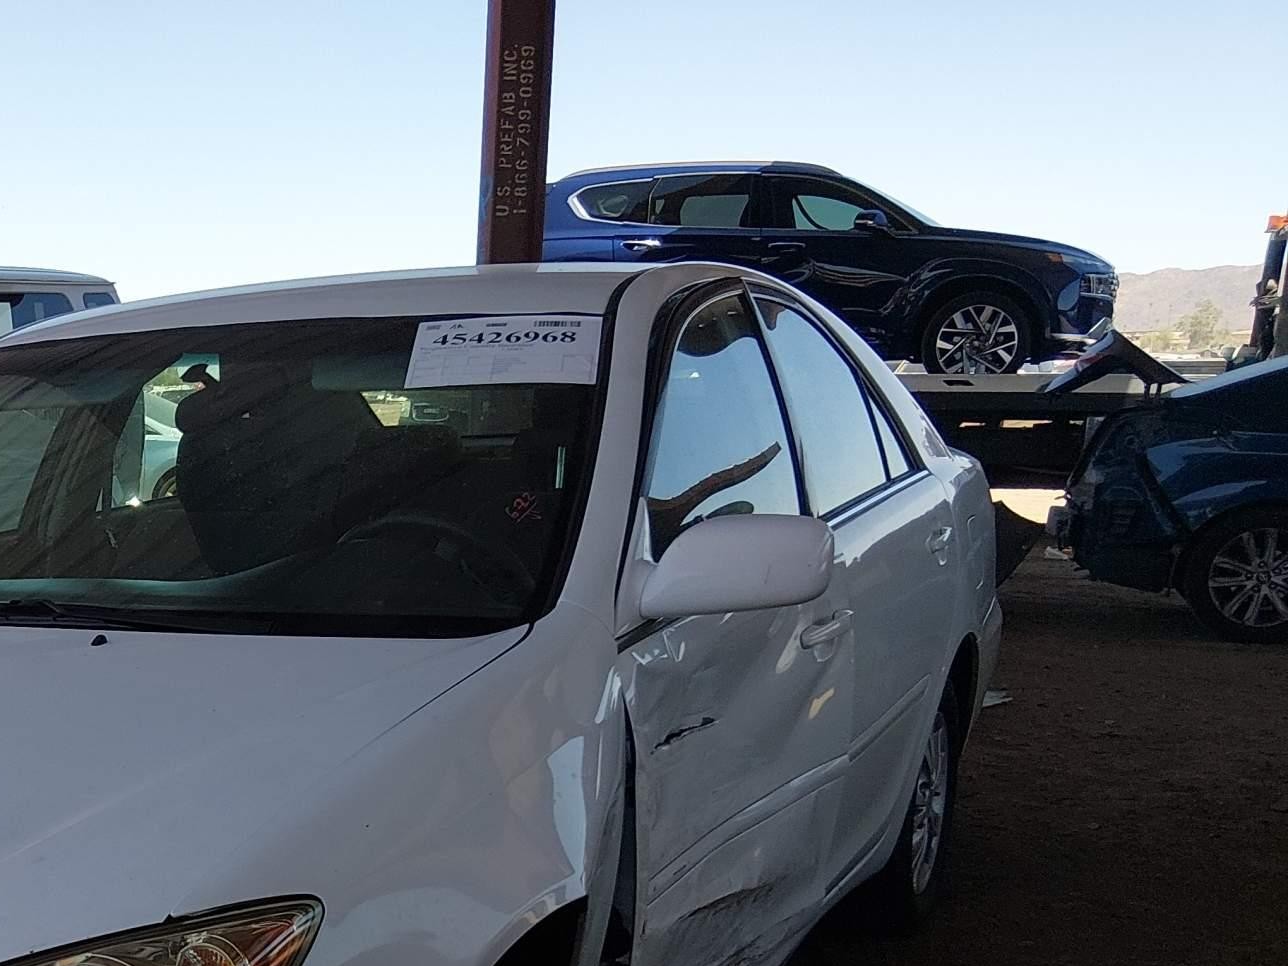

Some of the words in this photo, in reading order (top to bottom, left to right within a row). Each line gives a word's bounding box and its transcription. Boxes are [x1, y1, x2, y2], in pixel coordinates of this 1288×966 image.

[503, 44, 520, 81] INC.
[499, 92, 516, 168] PREFAB
[513, 45, 536, 215] 1-866-799-0969
[495, 181, 511, 217] U.S.
[432, 330, 577, 346] 45426968
